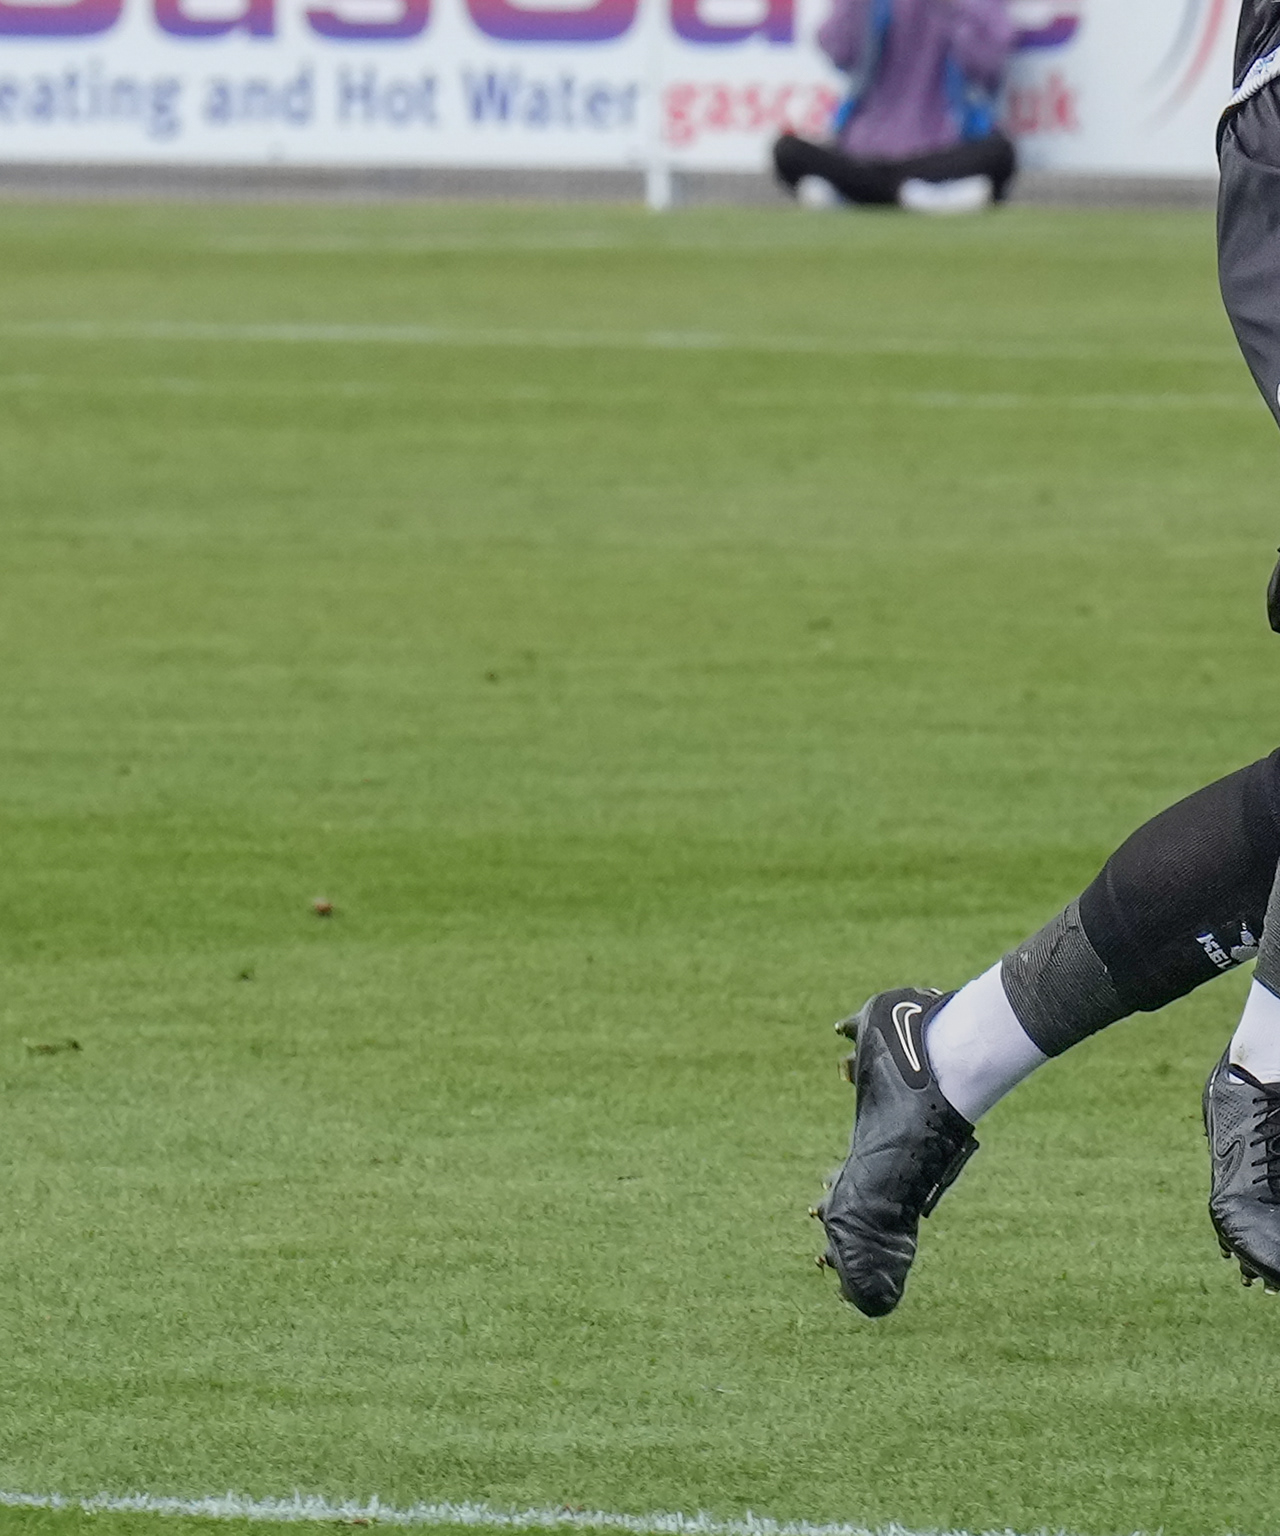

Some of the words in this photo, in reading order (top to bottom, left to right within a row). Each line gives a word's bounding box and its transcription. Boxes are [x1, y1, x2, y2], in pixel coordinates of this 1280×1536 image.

[202, 62, 314, 126] and
[336, 63, 443, 127] Hot
[461, 63, 644, 128] Water
